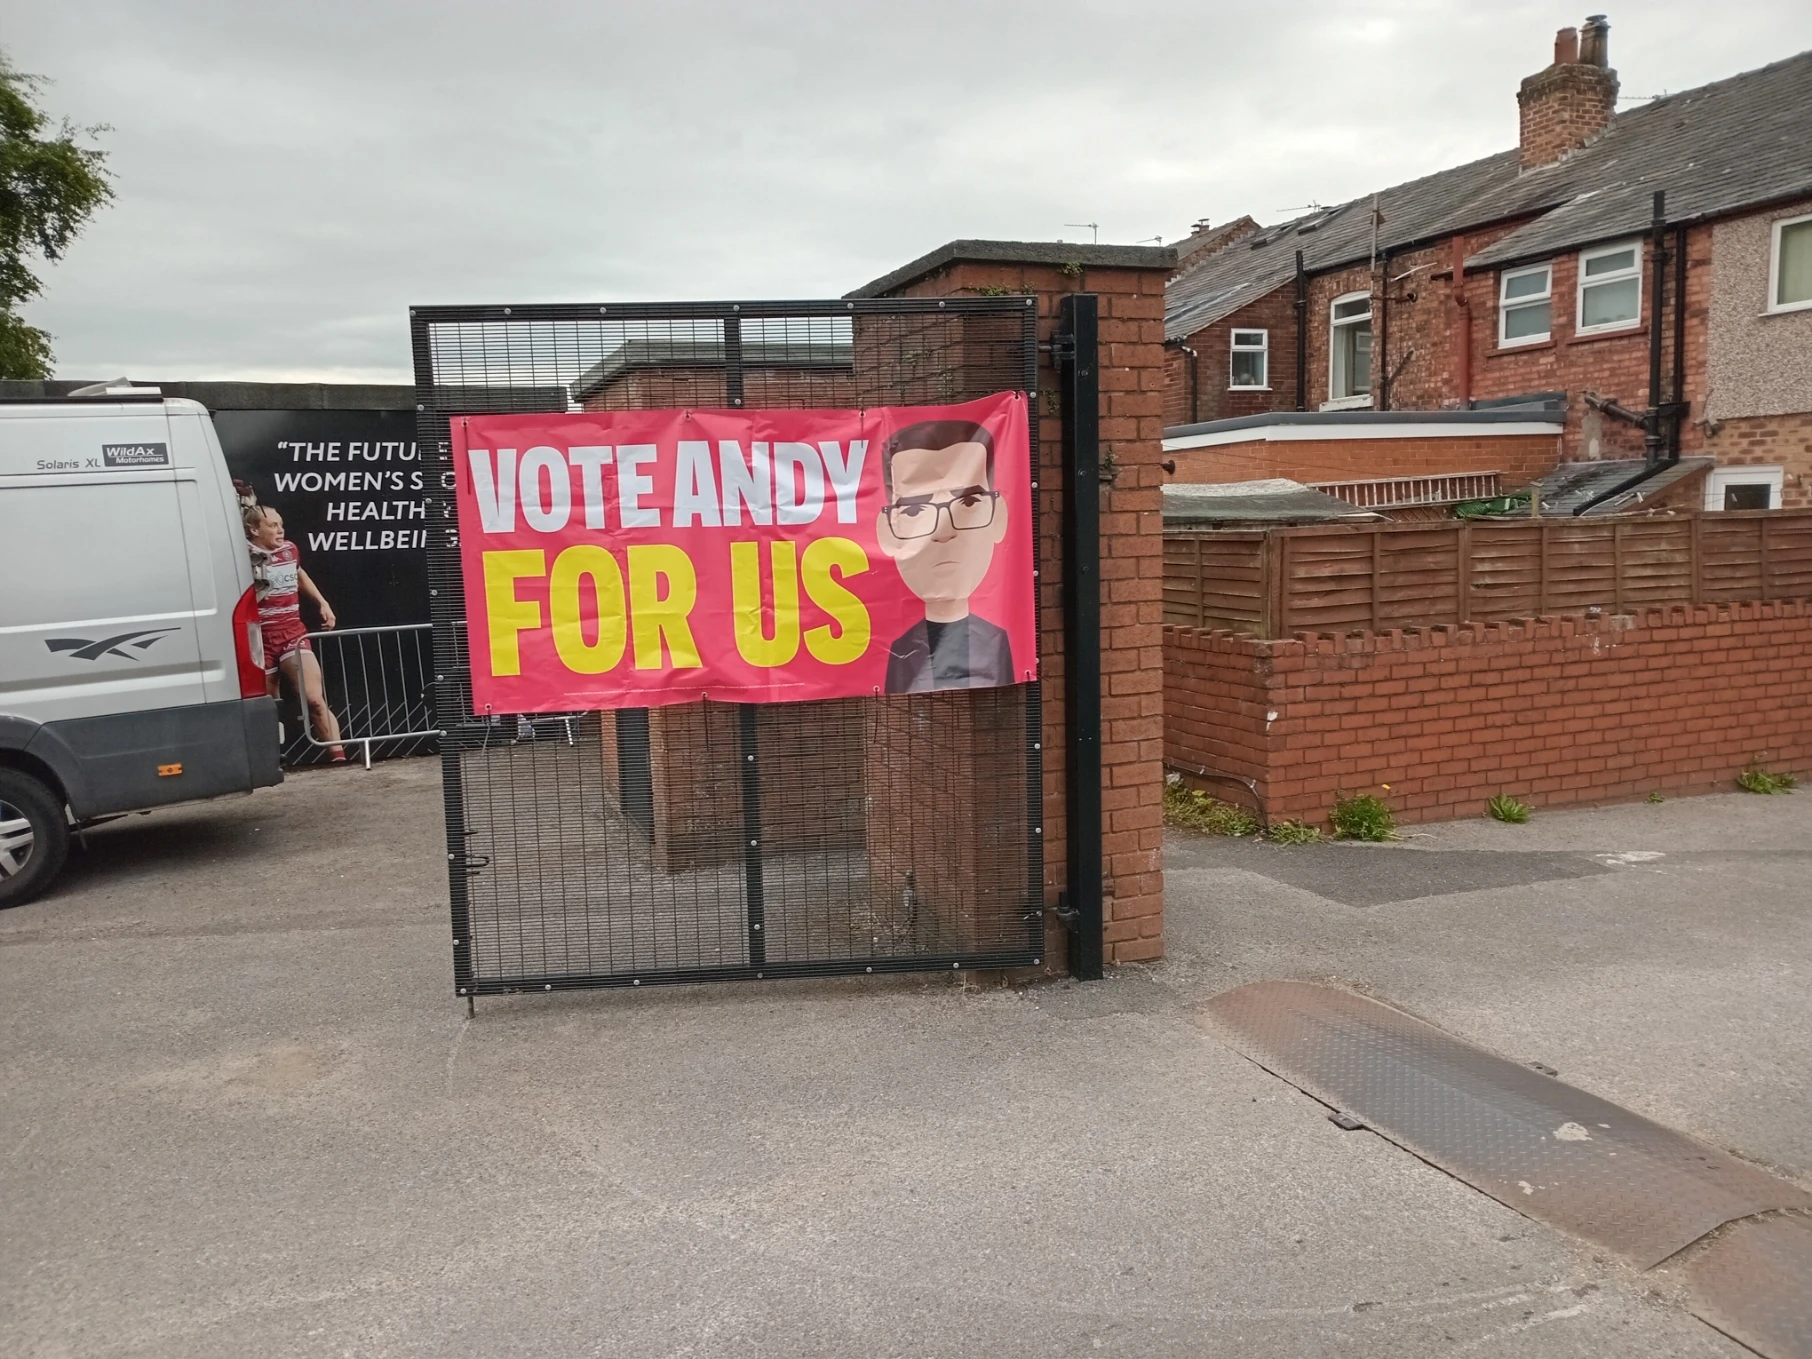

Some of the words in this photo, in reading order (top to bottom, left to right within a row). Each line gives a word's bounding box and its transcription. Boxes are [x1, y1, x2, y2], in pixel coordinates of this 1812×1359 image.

[106, 446, 155, 457] WildAx
[115, 456, 165, 464] Motorhomes
[36, 459, 80, 470] Solaris
[85, 457, 102, 468] XL
[467, 444, 659, 534] VOTE
[672, 439, 870, 528] ANDY
[326, 501, 426, 522] HEALTH
[482, 544, 703, 677] FOR
[729, 536, 871, 669] US
